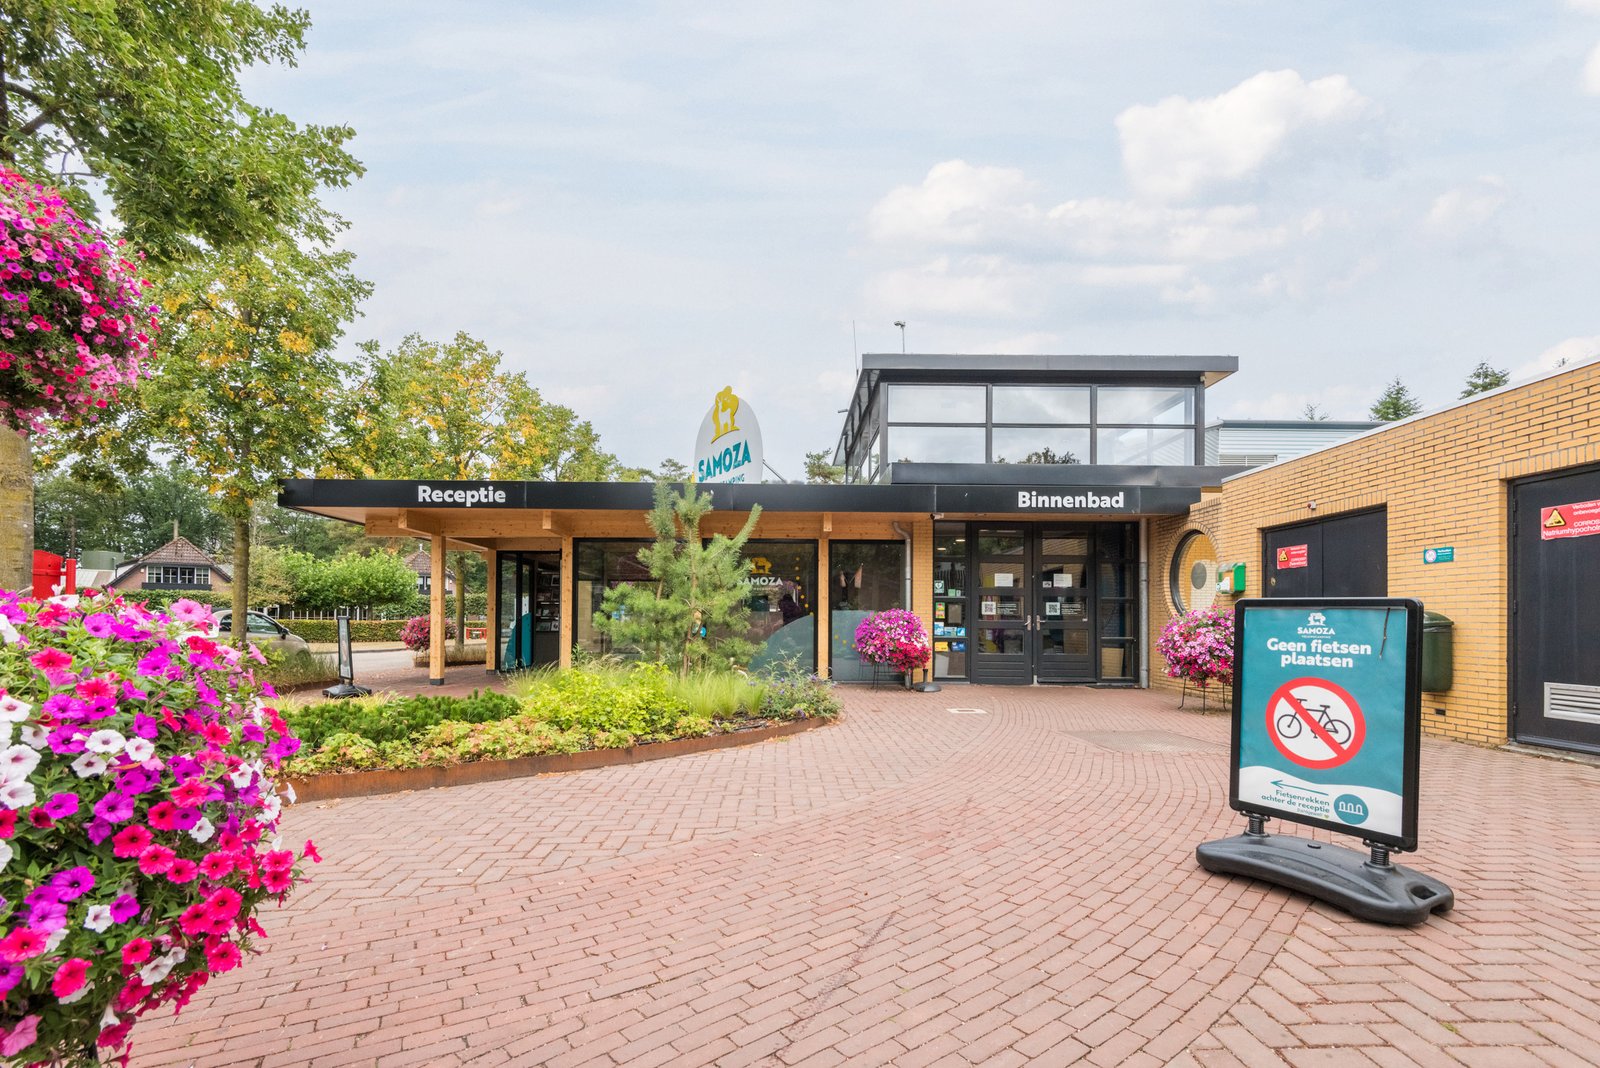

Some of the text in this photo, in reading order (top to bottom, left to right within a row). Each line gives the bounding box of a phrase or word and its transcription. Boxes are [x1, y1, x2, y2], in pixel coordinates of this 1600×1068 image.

[698, 440, 752, 482] SAMOZA
[418, 485, 506, 507] Receptie
[1017, 491, 1125, 508] Binnenbad
[1297, 627, 1336, 635] SAMOZA
[1266, 637, 1372, 655] Geen fietsen
[1281, 653, 1353, 668] plaatsen
[1261, 795, 1285, 803] achter
[1298, 802, 1330, 814] receptie
[1275, 790, 1330, 806] Fietsenrekken
